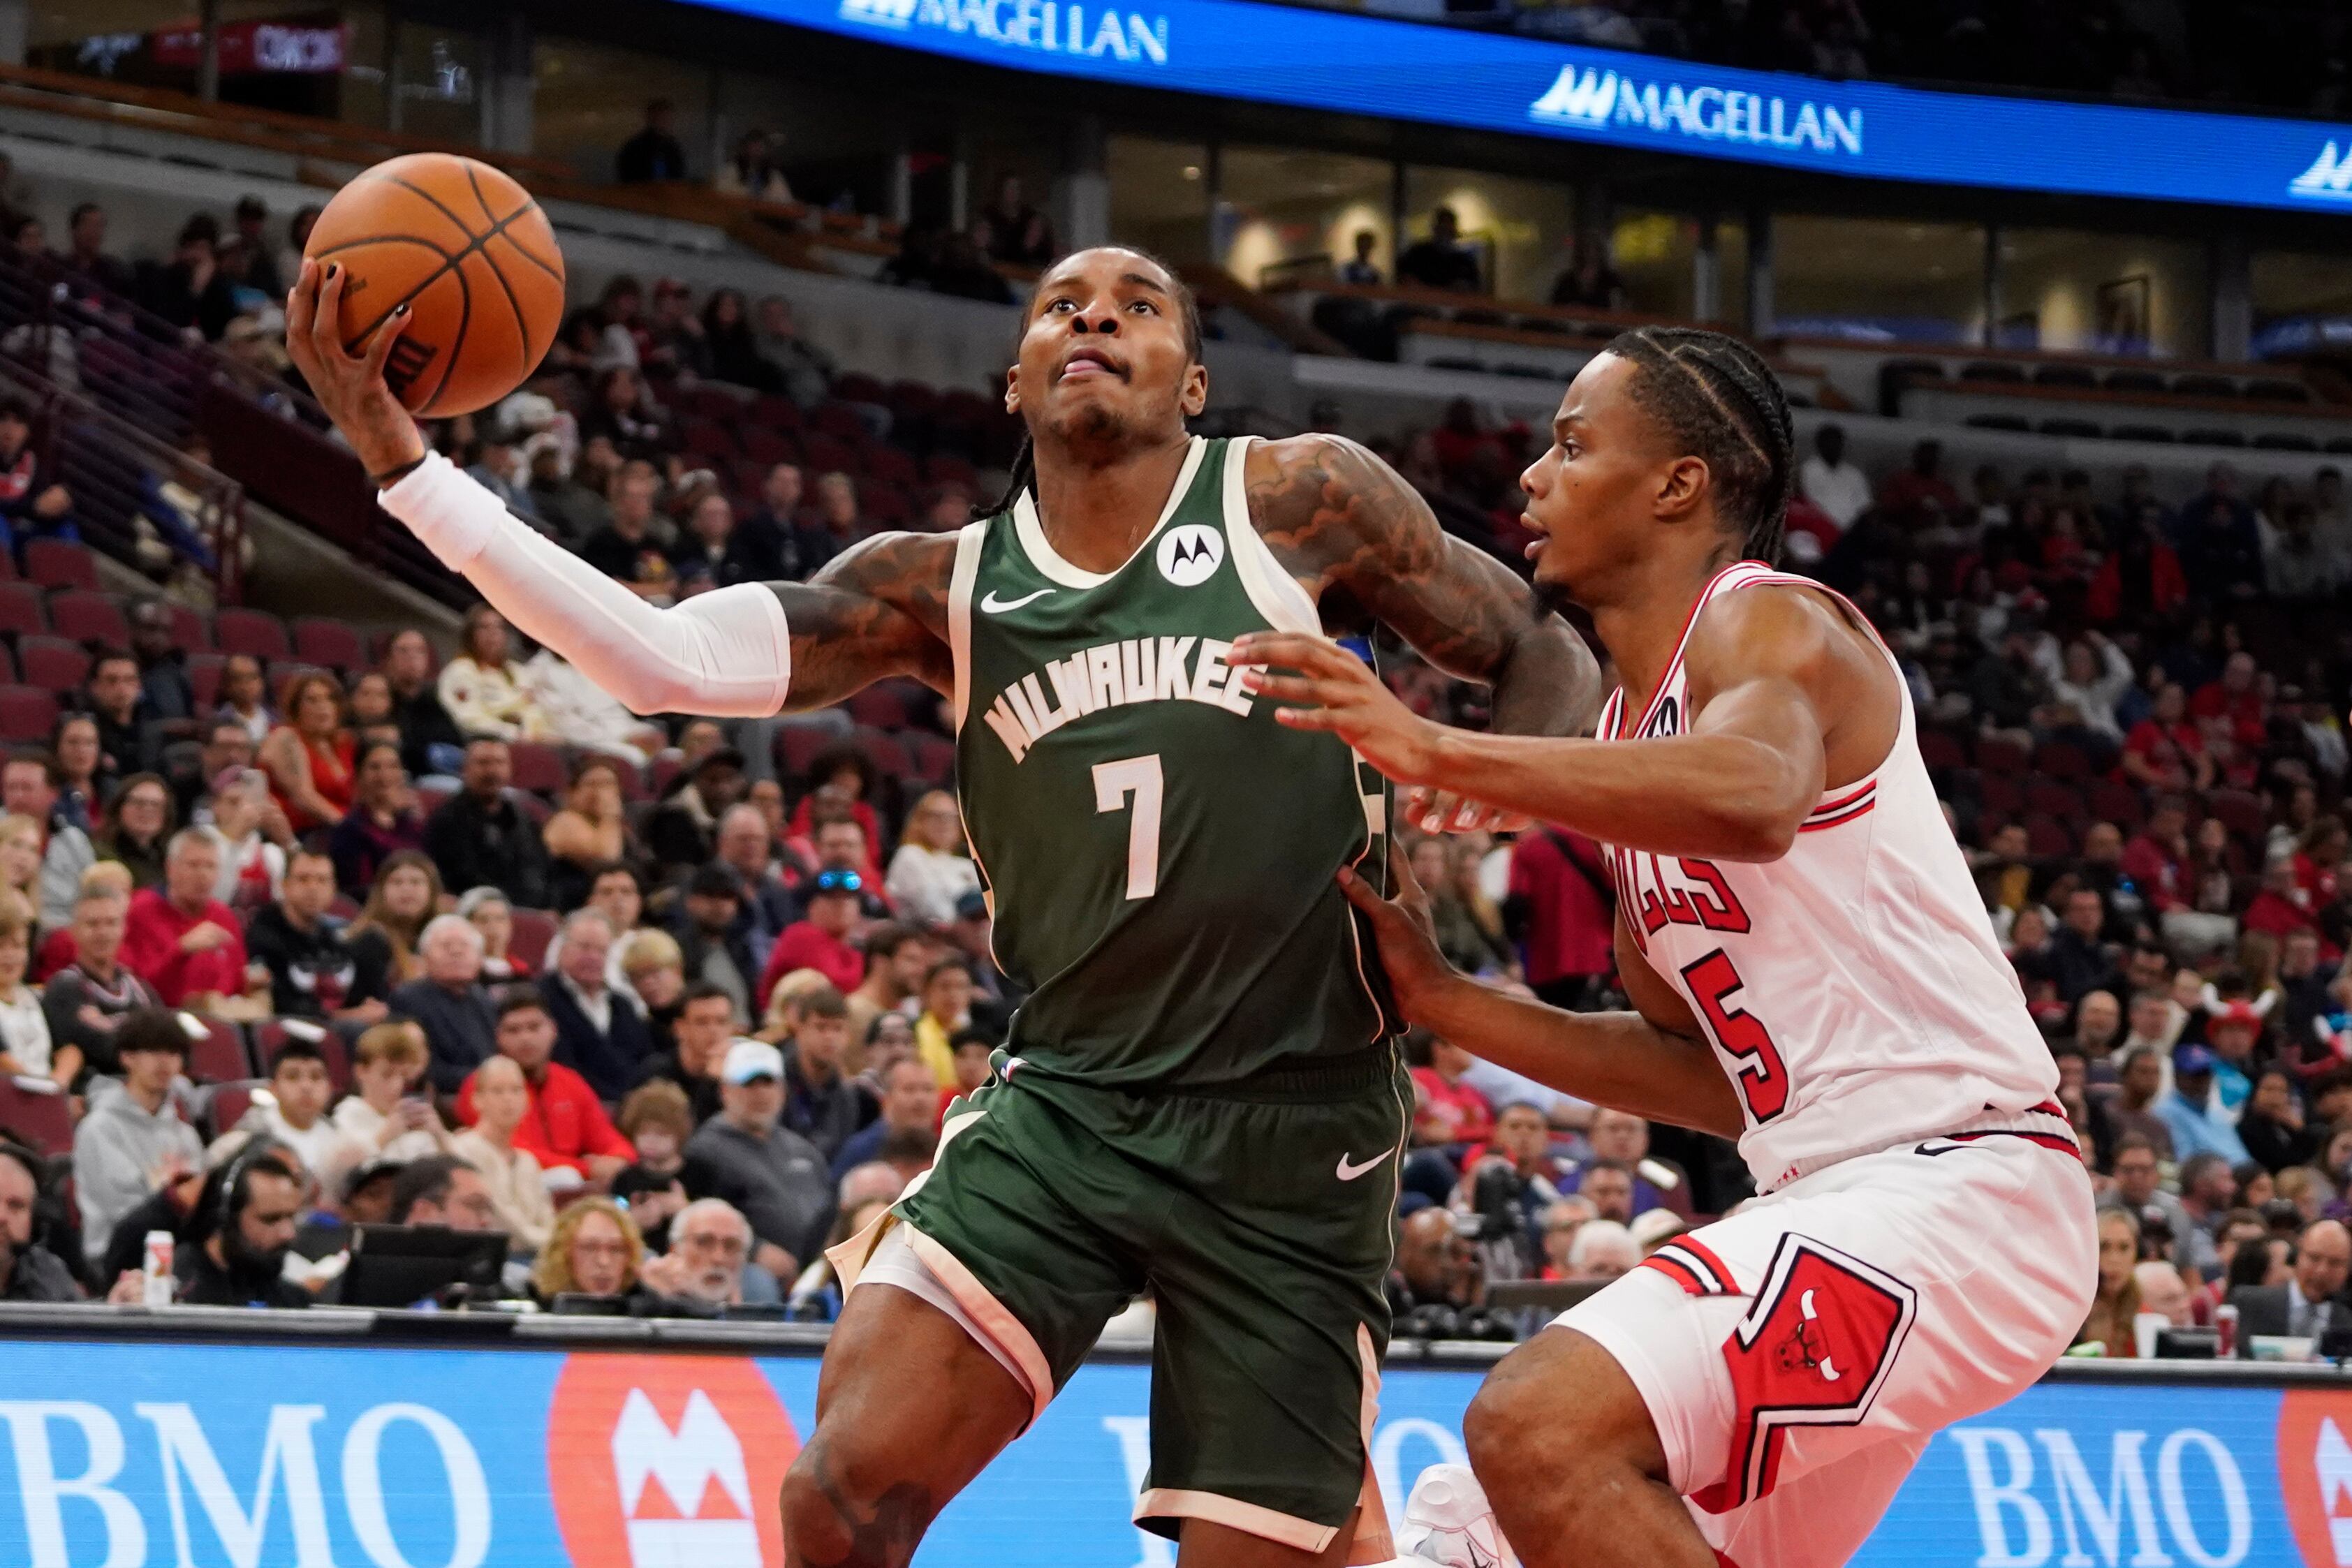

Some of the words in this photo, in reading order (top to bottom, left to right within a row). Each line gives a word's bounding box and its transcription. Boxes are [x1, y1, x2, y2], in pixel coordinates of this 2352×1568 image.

[916, 0, 1168, 64] MAGELLAN
[1615, 77, 1863, 155] MAGELLAN
[1092, 753, 1164, 901] 7
[1680, 947, 1790, 1125] 5
[0, 1400, 492, 1568] BMO
[1948, 1426, 2253, 1568] BMO
